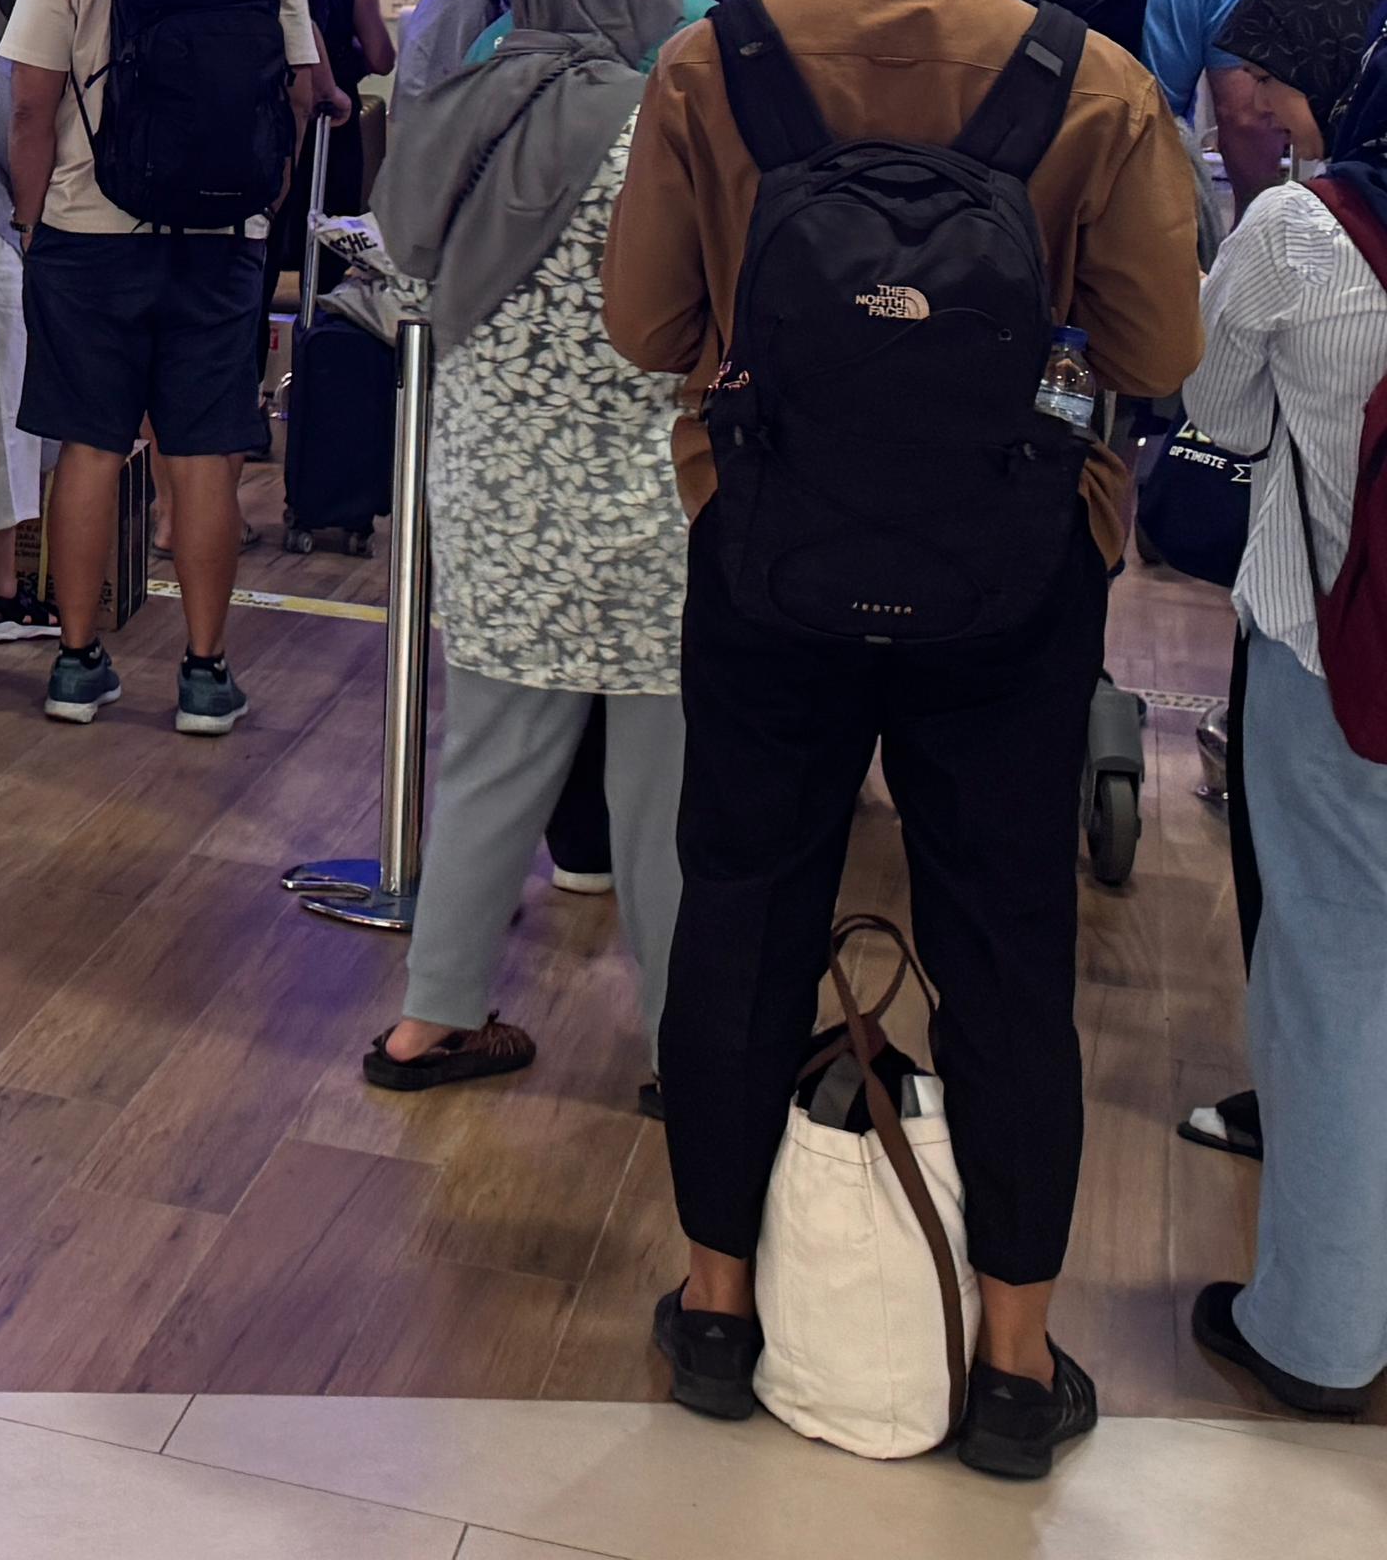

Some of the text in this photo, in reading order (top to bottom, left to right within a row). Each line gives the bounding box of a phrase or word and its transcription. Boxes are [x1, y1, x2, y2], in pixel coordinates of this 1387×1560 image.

[876, 285, 907, 297] THE
[855, 294, 905, 308] NORTH
[868, 305, 907, 318] FACE
[1168, 445, 1228, 470] OPTIMISTE
